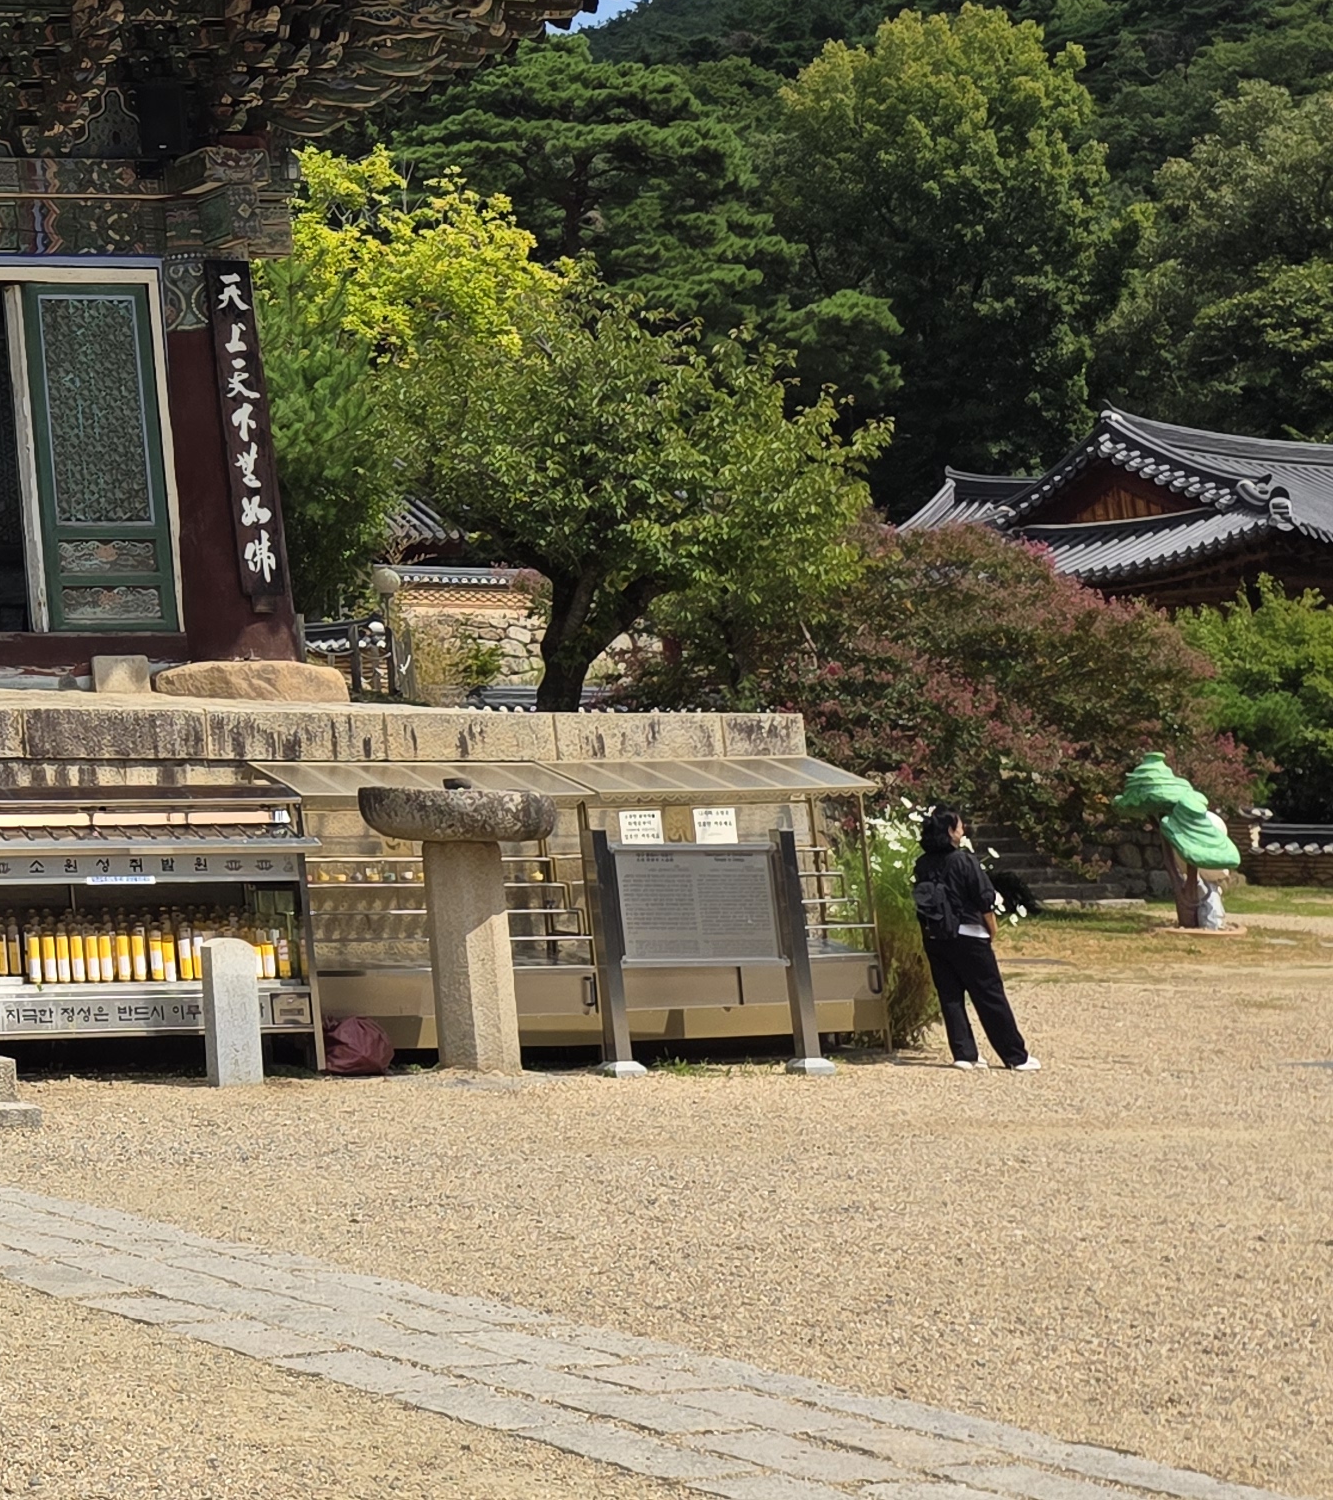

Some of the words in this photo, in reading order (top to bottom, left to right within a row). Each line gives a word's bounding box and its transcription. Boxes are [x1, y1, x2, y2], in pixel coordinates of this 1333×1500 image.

[5, 1007, 54, 1024] 지극한
[60, 1005, 110, 1023] 정성은
[117, 1005, 165, 1021] 반드시
